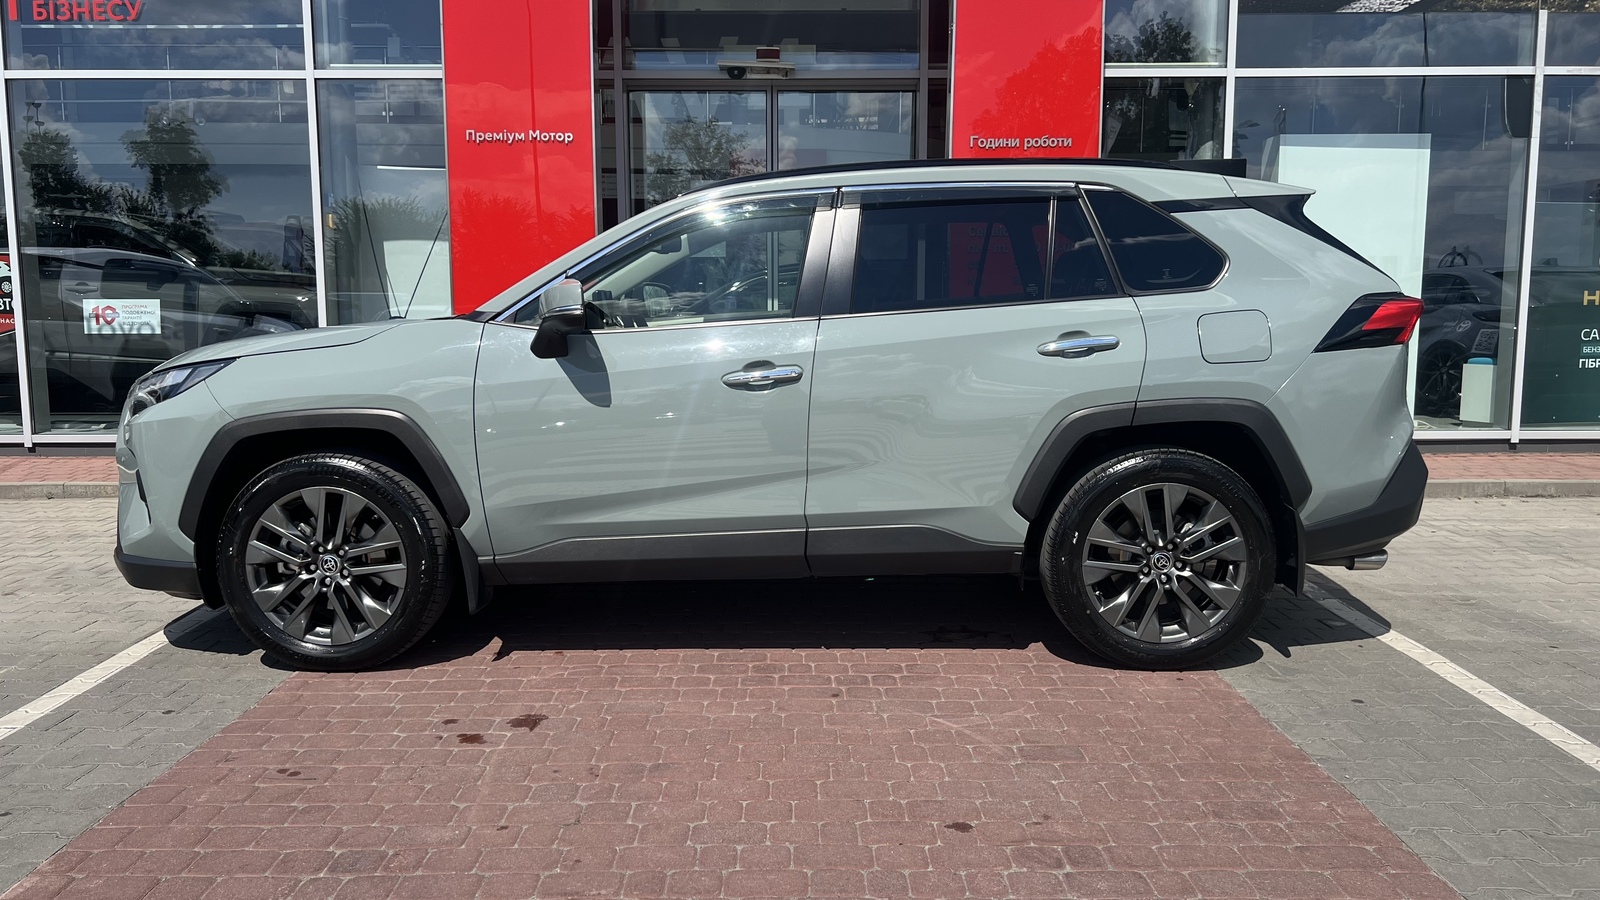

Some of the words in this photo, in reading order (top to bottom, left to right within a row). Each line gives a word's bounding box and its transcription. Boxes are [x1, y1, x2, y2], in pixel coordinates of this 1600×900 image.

[33, 0, 140, 20] БІЗНЕСУ
[465, 129, 525, 143] Преміум
[529, 129, 573, 143] Мотор
[970, 135, 1019, 149] Години
[1024, 135, 1072, 150] роботи
